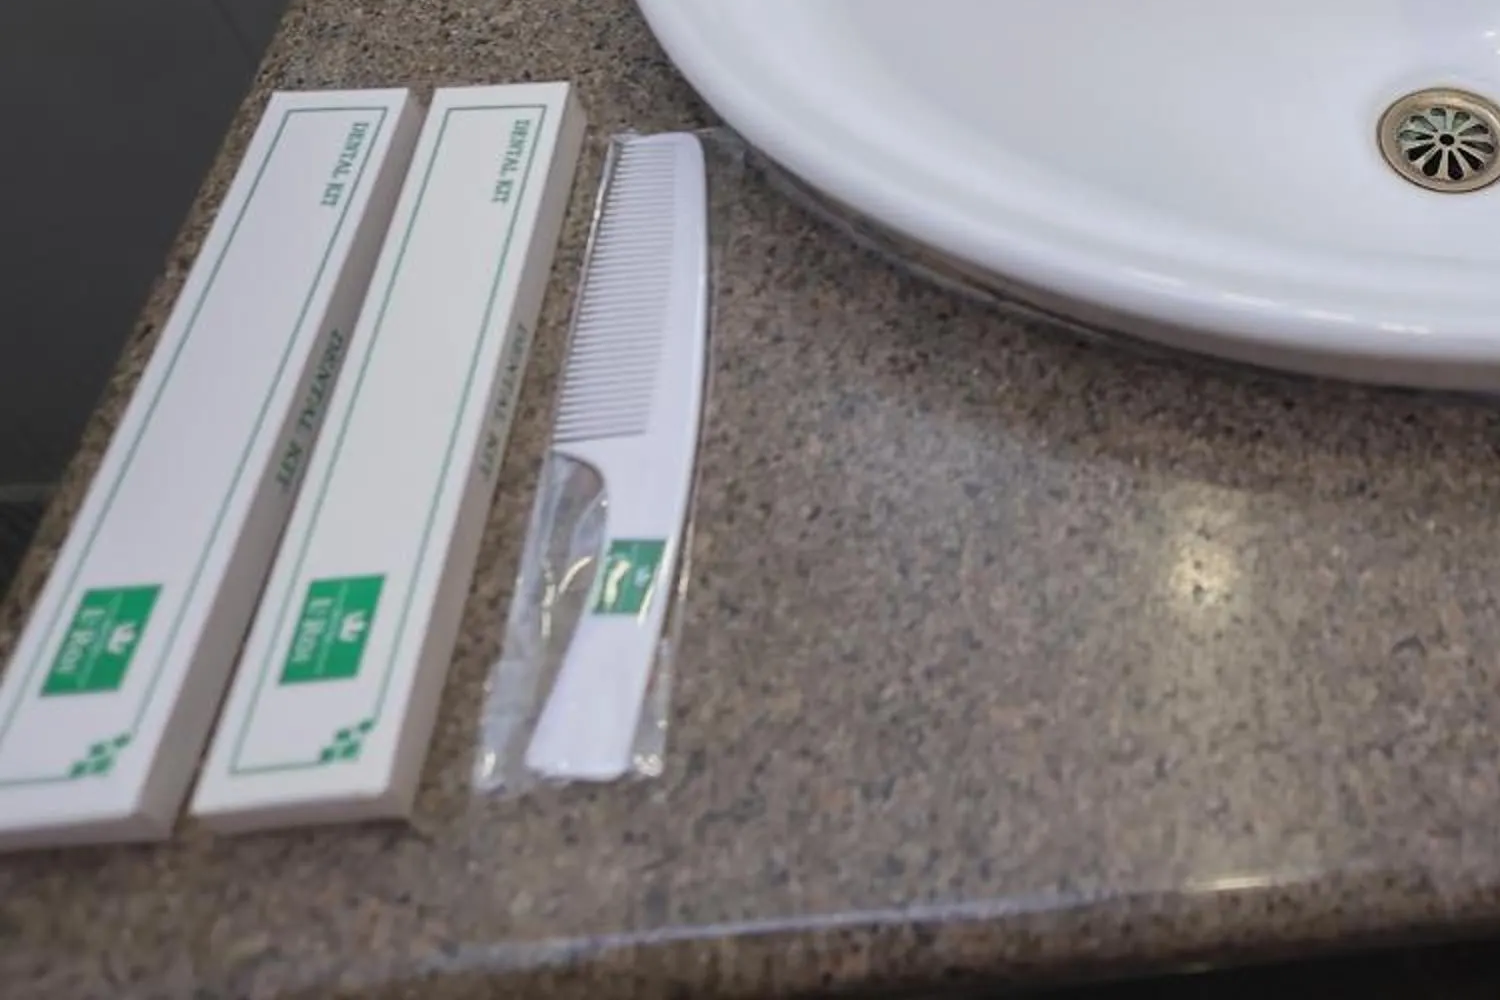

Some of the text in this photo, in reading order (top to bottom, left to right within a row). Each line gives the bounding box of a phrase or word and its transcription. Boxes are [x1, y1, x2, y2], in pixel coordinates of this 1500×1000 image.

[320, 121, 370, 207] DENTAL KIT
[491, 119, 531, 204] DENTAL KIT
